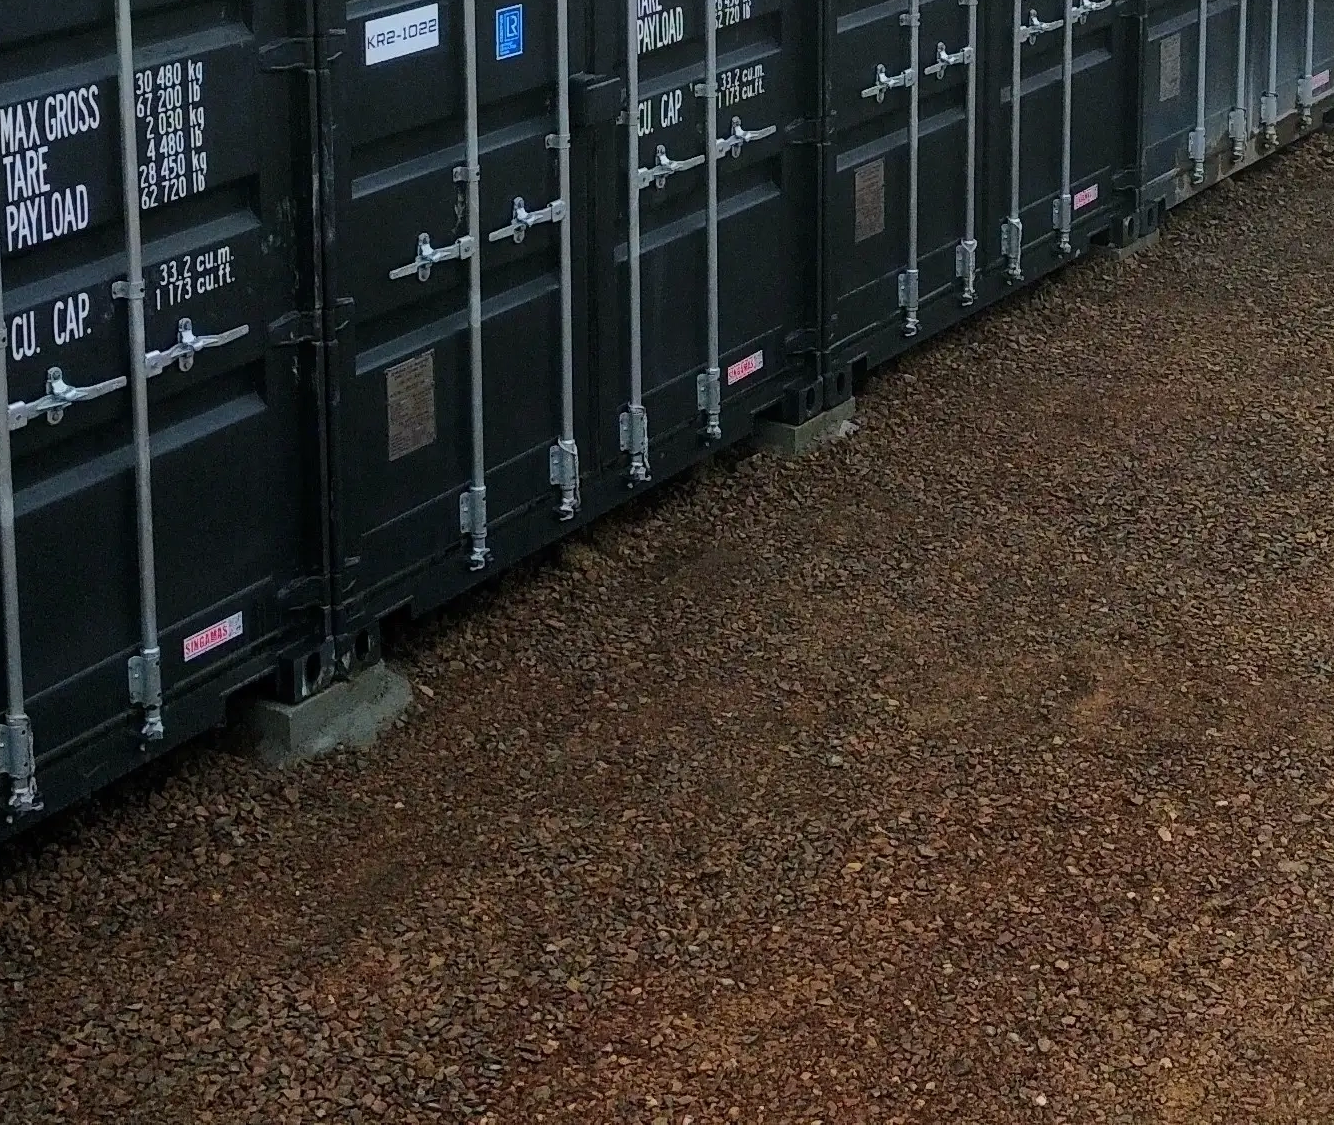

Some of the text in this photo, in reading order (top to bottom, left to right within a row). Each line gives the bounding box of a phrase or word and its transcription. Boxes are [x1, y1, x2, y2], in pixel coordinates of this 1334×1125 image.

[637, 6, 684, 55] PAYLOAD
[725, 6, 739, 26] 720
[743, 2, 750, 19] lb
[368, 18, 436, 50] KR2-1022
[136, 60, 202, 94] 30 480 kg
[721, 64, 765, 90] 33.2 cu.m.
[726, 86, 739, 106] 173
[742, 78, 765, 99] cu.ft.
[137, 81, 200, 117] 67 200 lb
[638, 89, 682, 136] CU. CAP.
[0, 85, 100, 156] MAX GROSS
[146, 104, 204, 139] 2 030 kg
[147, 126, 202, 161] 4 480 lb
[3, 146, 51, 202] TARE
[139, 150, 207, 188] 28 450 kg
[141, 171, 205, 209] 62 720 lb
[6, 184, 88, 251] PAYLOAD
[160, 246, 234, 285] 33.2 cu.m.
[156, 263, 235, 310] 1 173 cu.ft.
[12, 293, 91, 360] CU. CAP.
[185, 625, 228, 655] SINGAMAS
